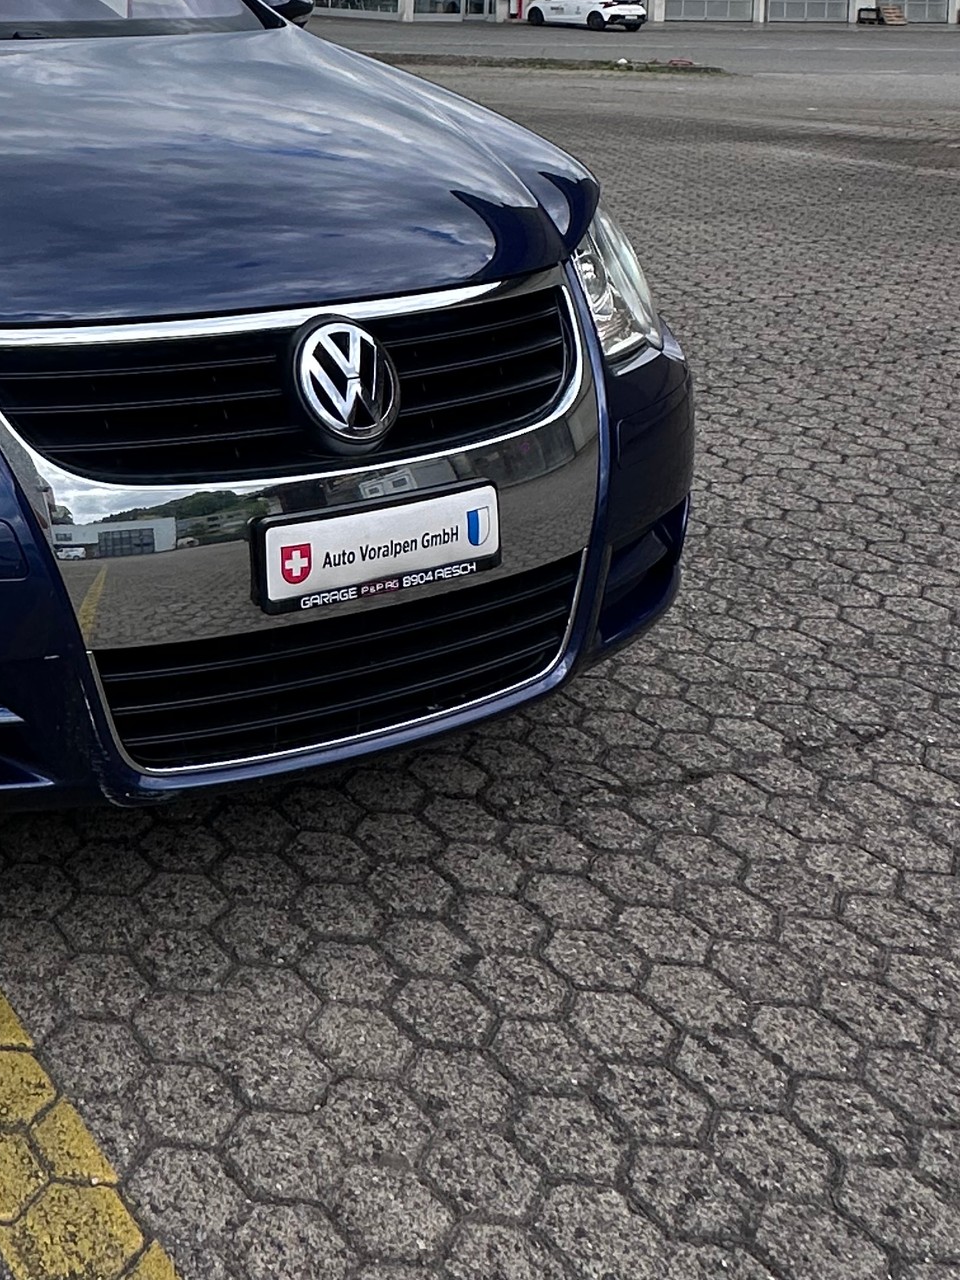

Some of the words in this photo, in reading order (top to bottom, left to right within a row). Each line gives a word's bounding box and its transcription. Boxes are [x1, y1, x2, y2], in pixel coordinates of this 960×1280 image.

[323, 550, 356, 569] Auto
[359, 538, 418, 562] Voralpen
[421, 525, 459, 549] GmbH
[300, 586, 358, 609] GARAGE
[402, 570, 434, 588] 8904
[434, 562, 477, 580] AESCH
